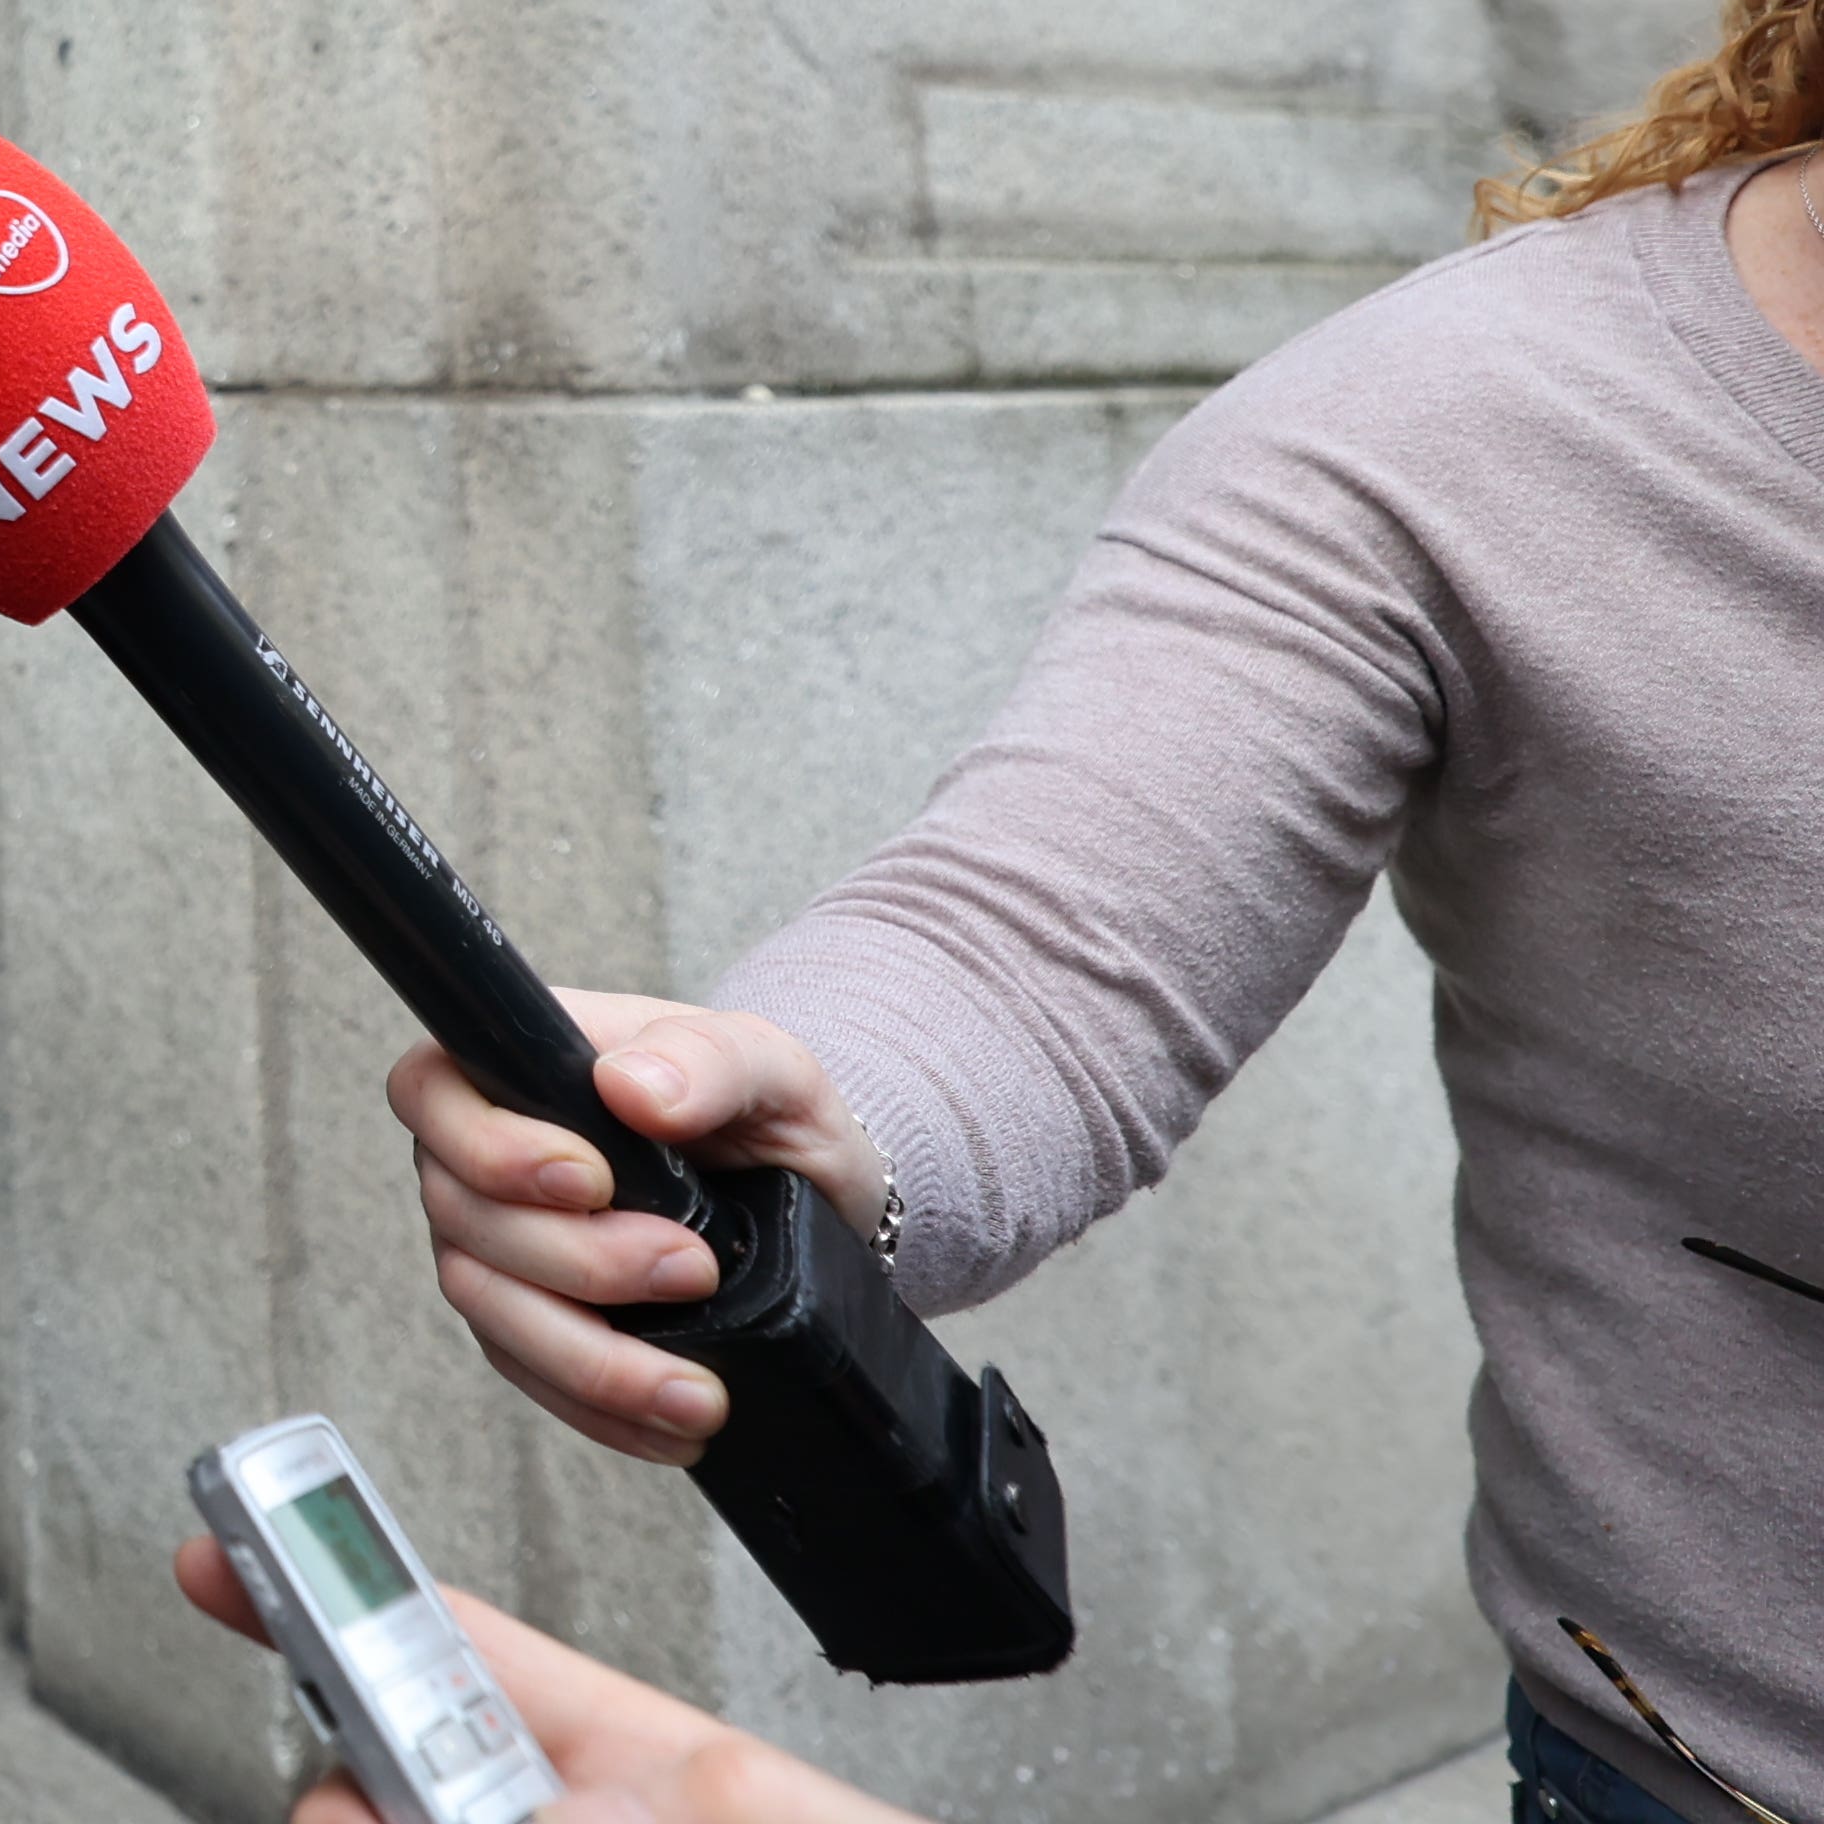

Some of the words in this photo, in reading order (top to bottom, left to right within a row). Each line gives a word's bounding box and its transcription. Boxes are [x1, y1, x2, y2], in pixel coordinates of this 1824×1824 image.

[291, 679, 440, 869] SENNHEISER
[452, 878, 480, 917] MD
[482, 918, 503, 947] 46
[347, 776, 377, 814] MADE
[375, 810, 388, 827] IN
[386, 824, 433, 881] GERMANY
